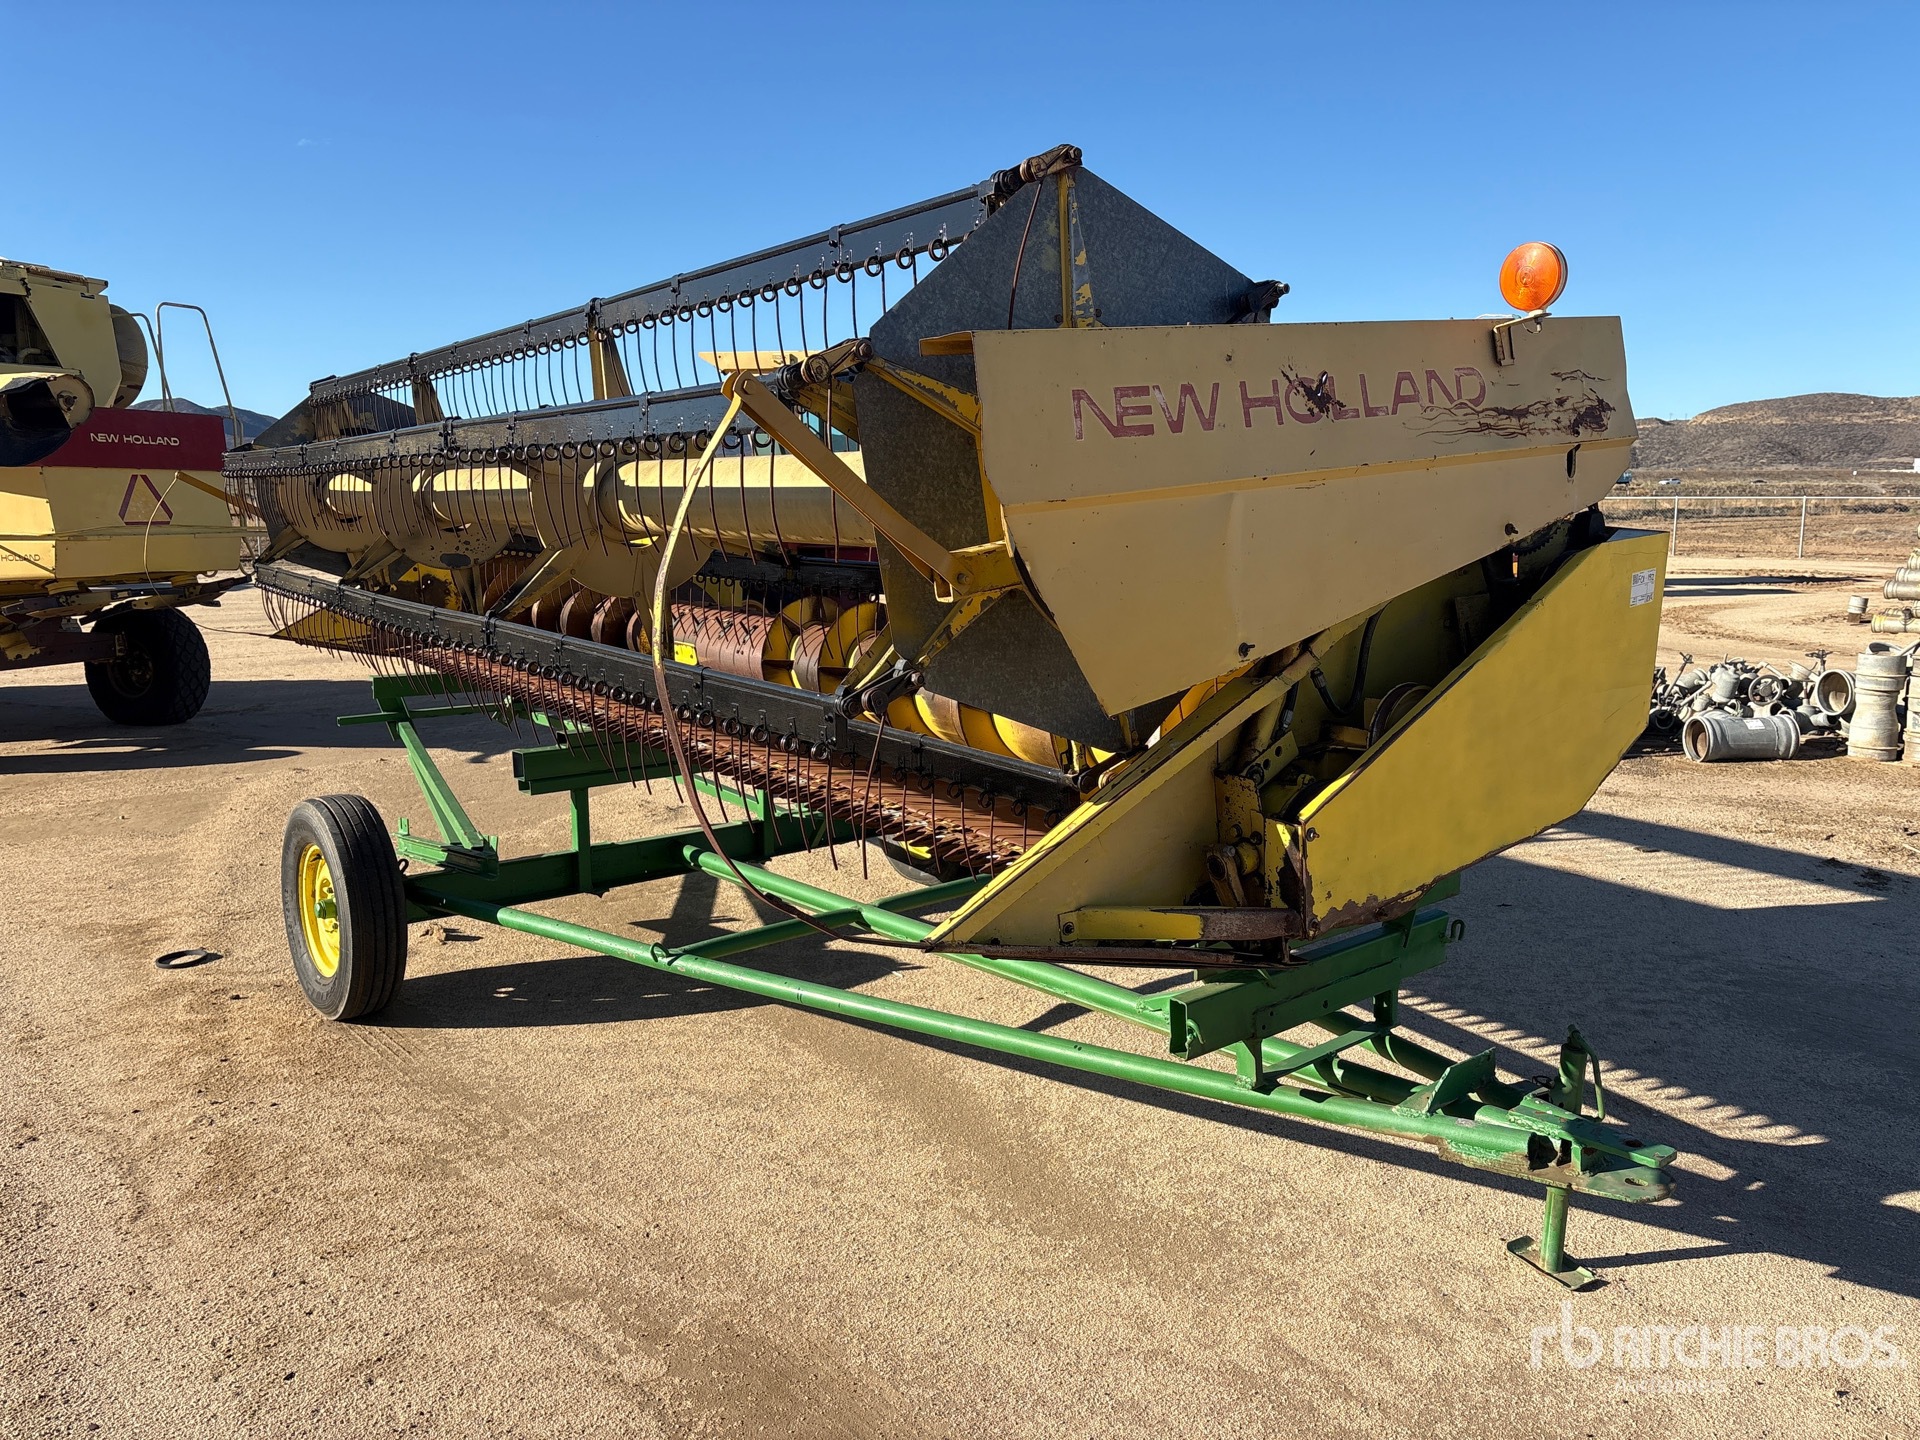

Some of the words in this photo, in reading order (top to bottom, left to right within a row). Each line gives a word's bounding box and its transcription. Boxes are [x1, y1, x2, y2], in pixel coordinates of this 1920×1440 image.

[1071, 382, 1220, 441] NEW
[1239, 367, 1487, 427] HOLLAND
[90, 433, 119, 443] NEW
[123, 434, 180, 446] HOLLAND
